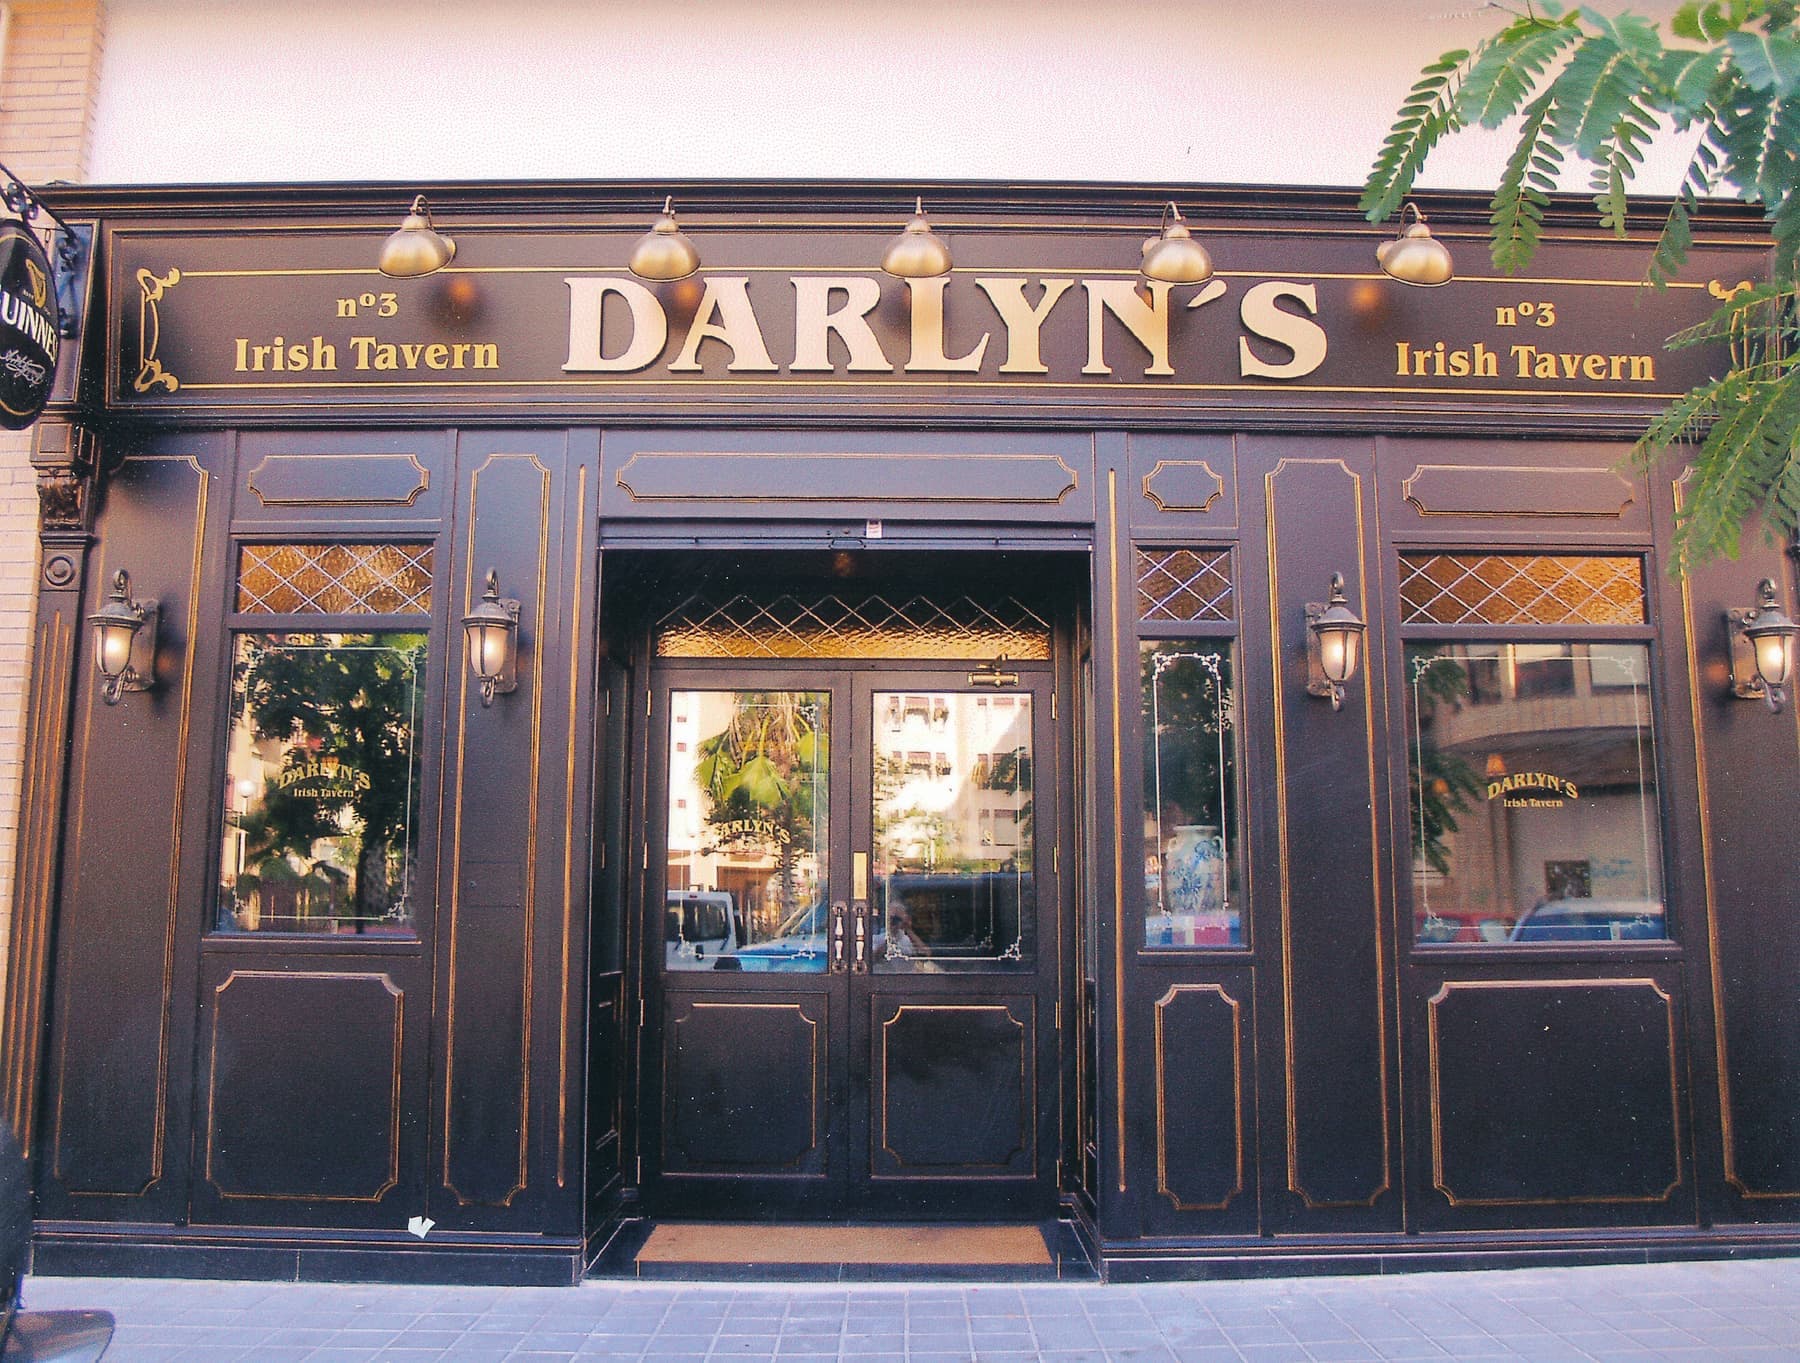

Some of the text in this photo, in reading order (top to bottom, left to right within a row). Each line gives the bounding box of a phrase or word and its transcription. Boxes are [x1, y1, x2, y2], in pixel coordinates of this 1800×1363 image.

[561, 275, 1328, 380] DARLYN'S
[234, 336, 500, 372] Irish Tavern
[1395, 342, 1655, 381] Irish Tavern
[293, 788, 355, 798] Irish Tavern
[1487, 772, 1578, 800] DARLYN'S
[1503, 798, 1563, 808] Irish Tavern
